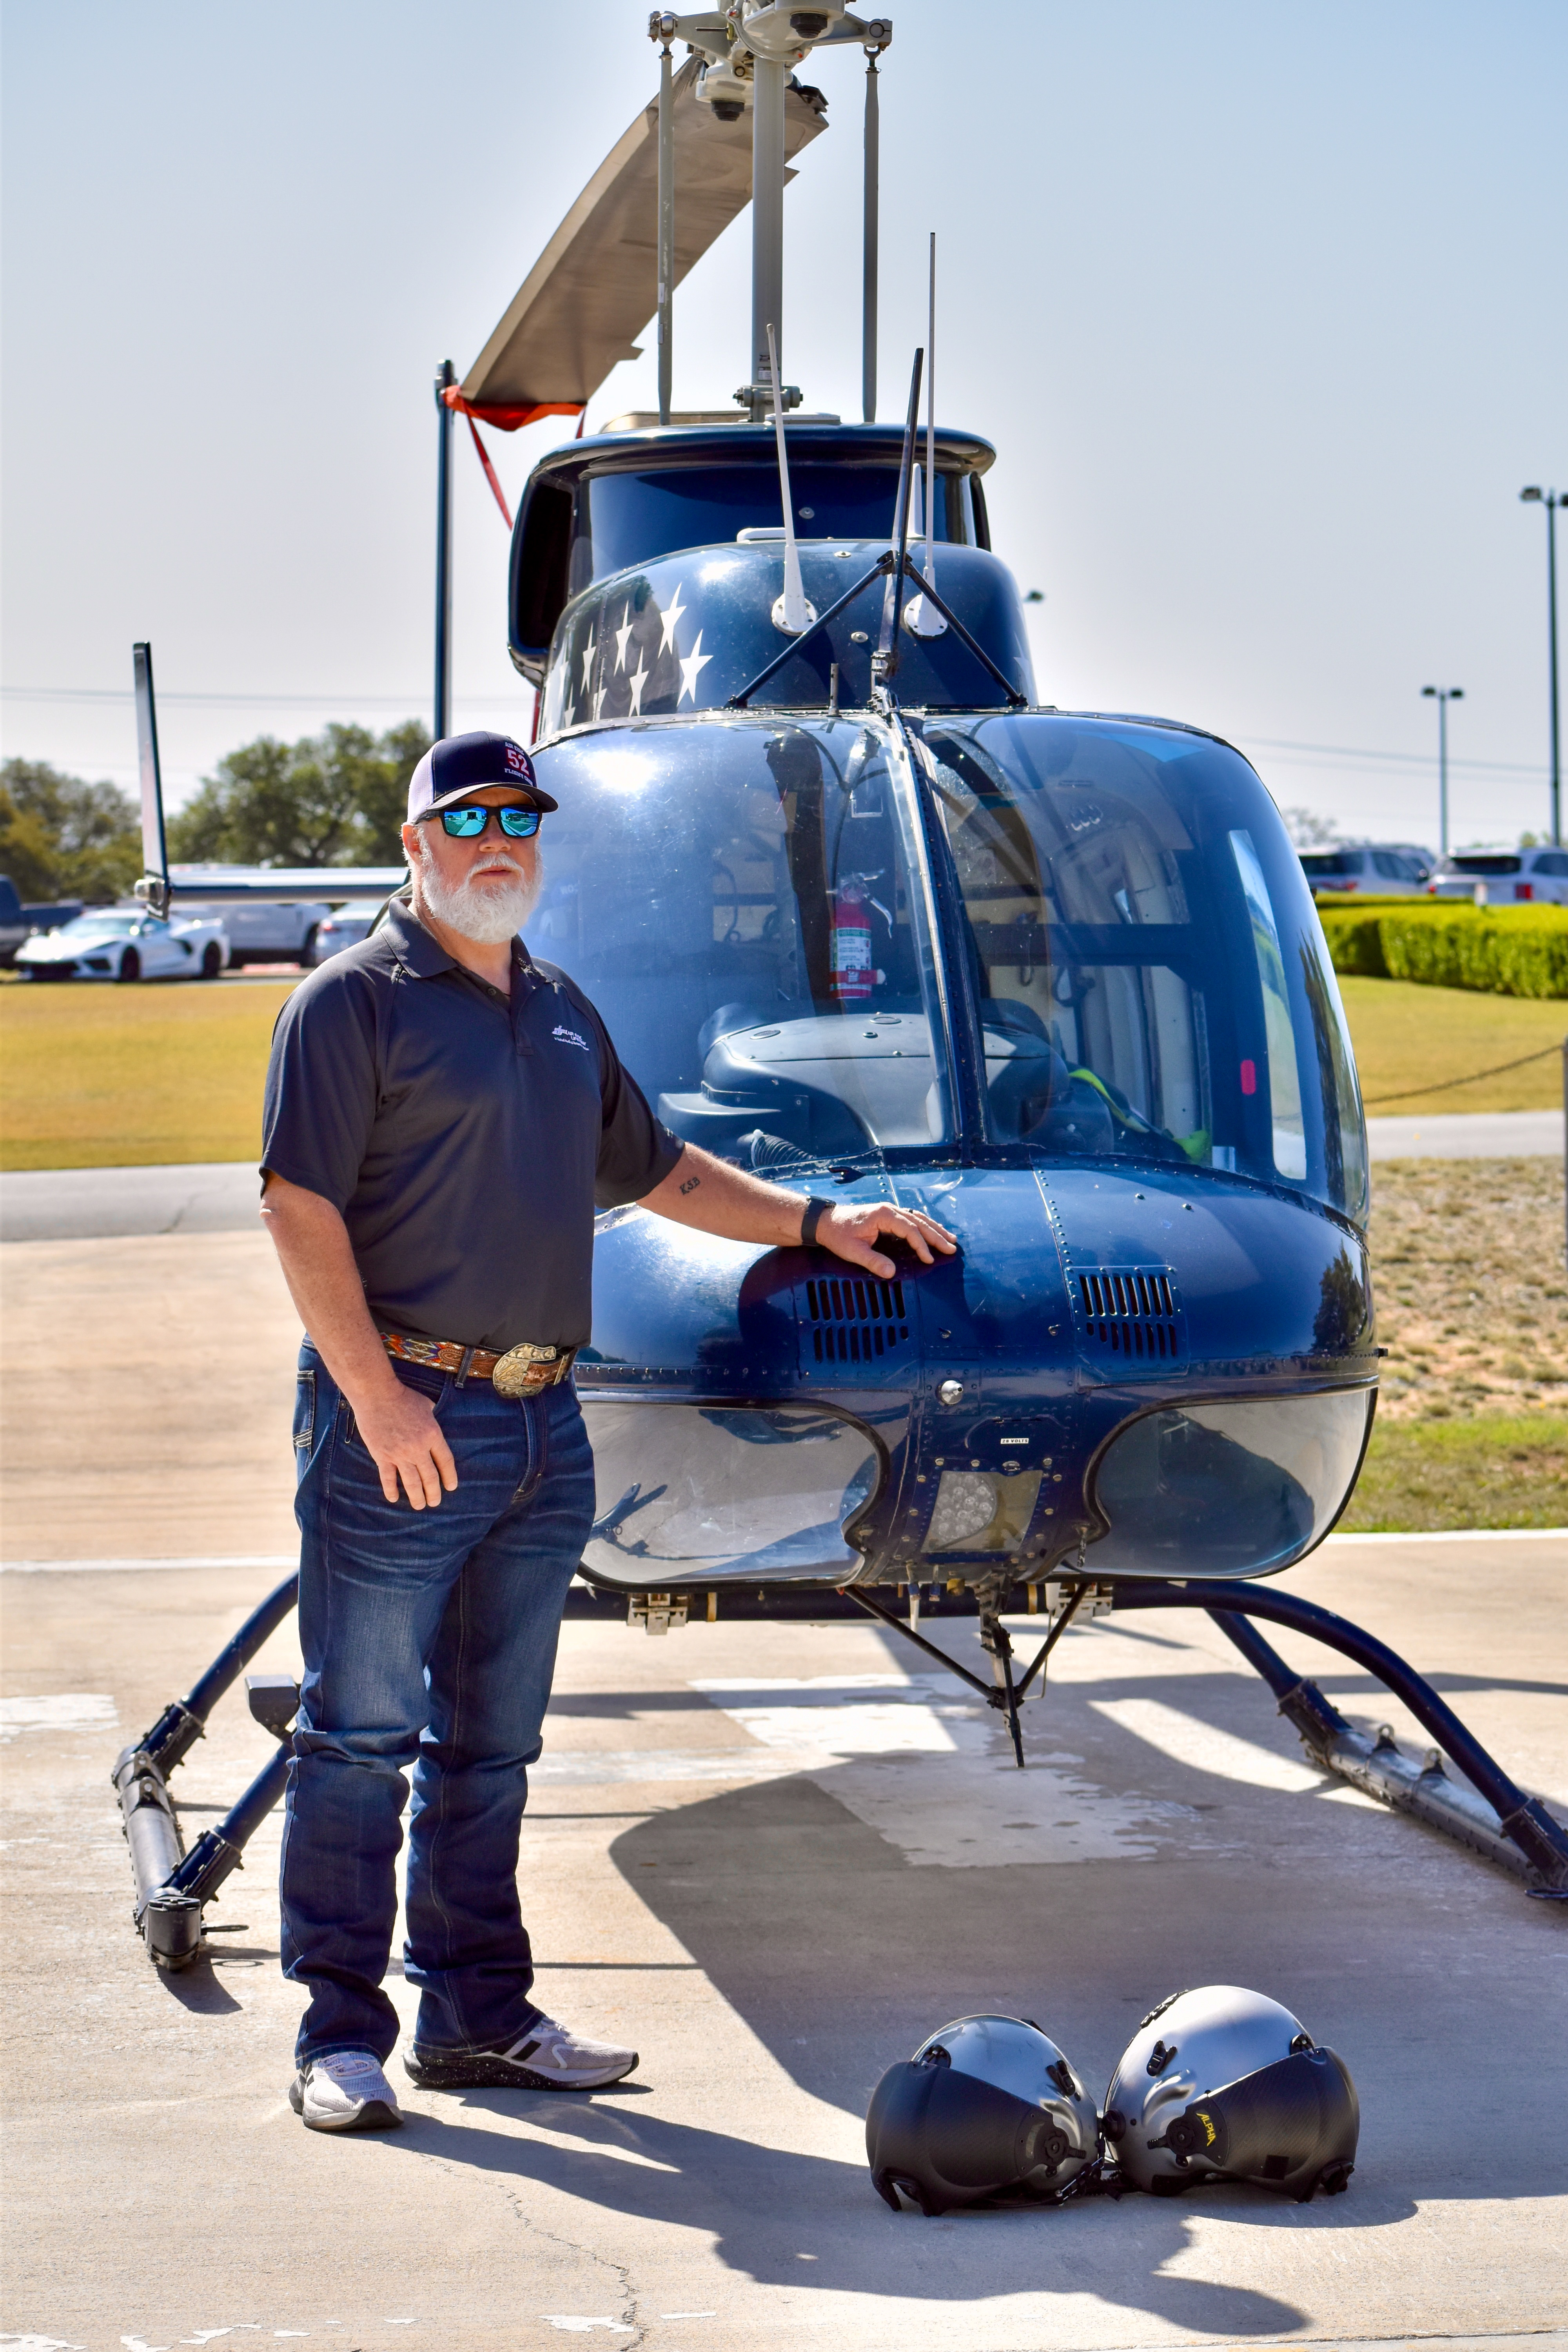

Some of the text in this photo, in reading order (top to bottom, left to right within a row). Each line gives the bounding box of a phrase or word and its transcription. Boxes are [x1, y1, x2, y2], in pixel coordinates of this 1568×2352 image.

[507, 749, 529, 775] 52
[504, 768, 524, 779] FLIGHT
[679, 1177, 700, 1195] KSB
[1196, 2113, 1216, 2147] ALPHA
